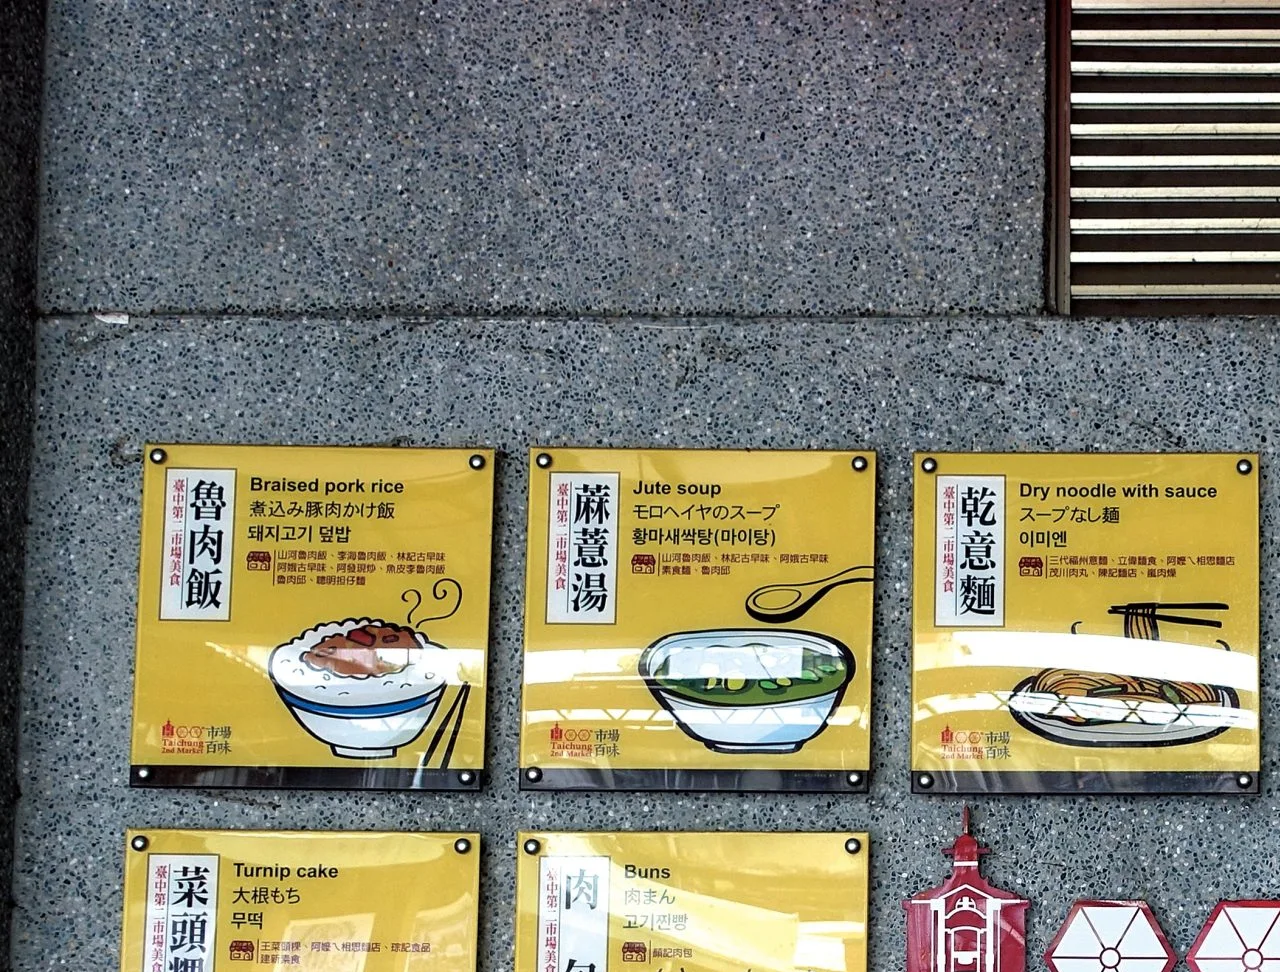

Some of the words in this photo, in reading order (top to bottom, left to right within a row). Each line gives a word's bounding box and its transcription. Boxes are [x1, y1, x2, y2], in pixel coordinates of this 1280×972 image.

[251, 478, 318, 492] Braised
[325, 479, 365, 495] pork
[372, 480, 404, 493] rice
[633, 481, 671, 495] Jute
[677, 482, 721, 498] soup
[1020, 484, 1049, 500] Dry
[1057, 484, 1116, 497] noodle
[1123, 484, 1159, 497] with
[1165, 486, 1217, 498] sauce
[250, 501, 395, 519] 煮込み豚肉かけ飯
[633, 504, 780, 521] モロヘイヤのスープ
[248, 526, 313, 542] 돼지고기
[319, 526, 351, 543] 덮밥
[632, 529, 776, 546] 황마새싹탕(마이탕)
[1020, 531, 1067, 548] 이미엔
[185, 480, 227, 609] 魯肉飯
[960, 487, 996, 616] 乾意麵
[234, 863, 290, 880] Turnip
[297, 864, 338, 878] cake
[624, 865, 671, 879] Buns
[232, 887, 300, 904] 大根もち
[624, 888, 675, 905] 肉まん
[231, 912, 264, 930] 무떡
[623, 913, 688, 931] 고기찐빵
